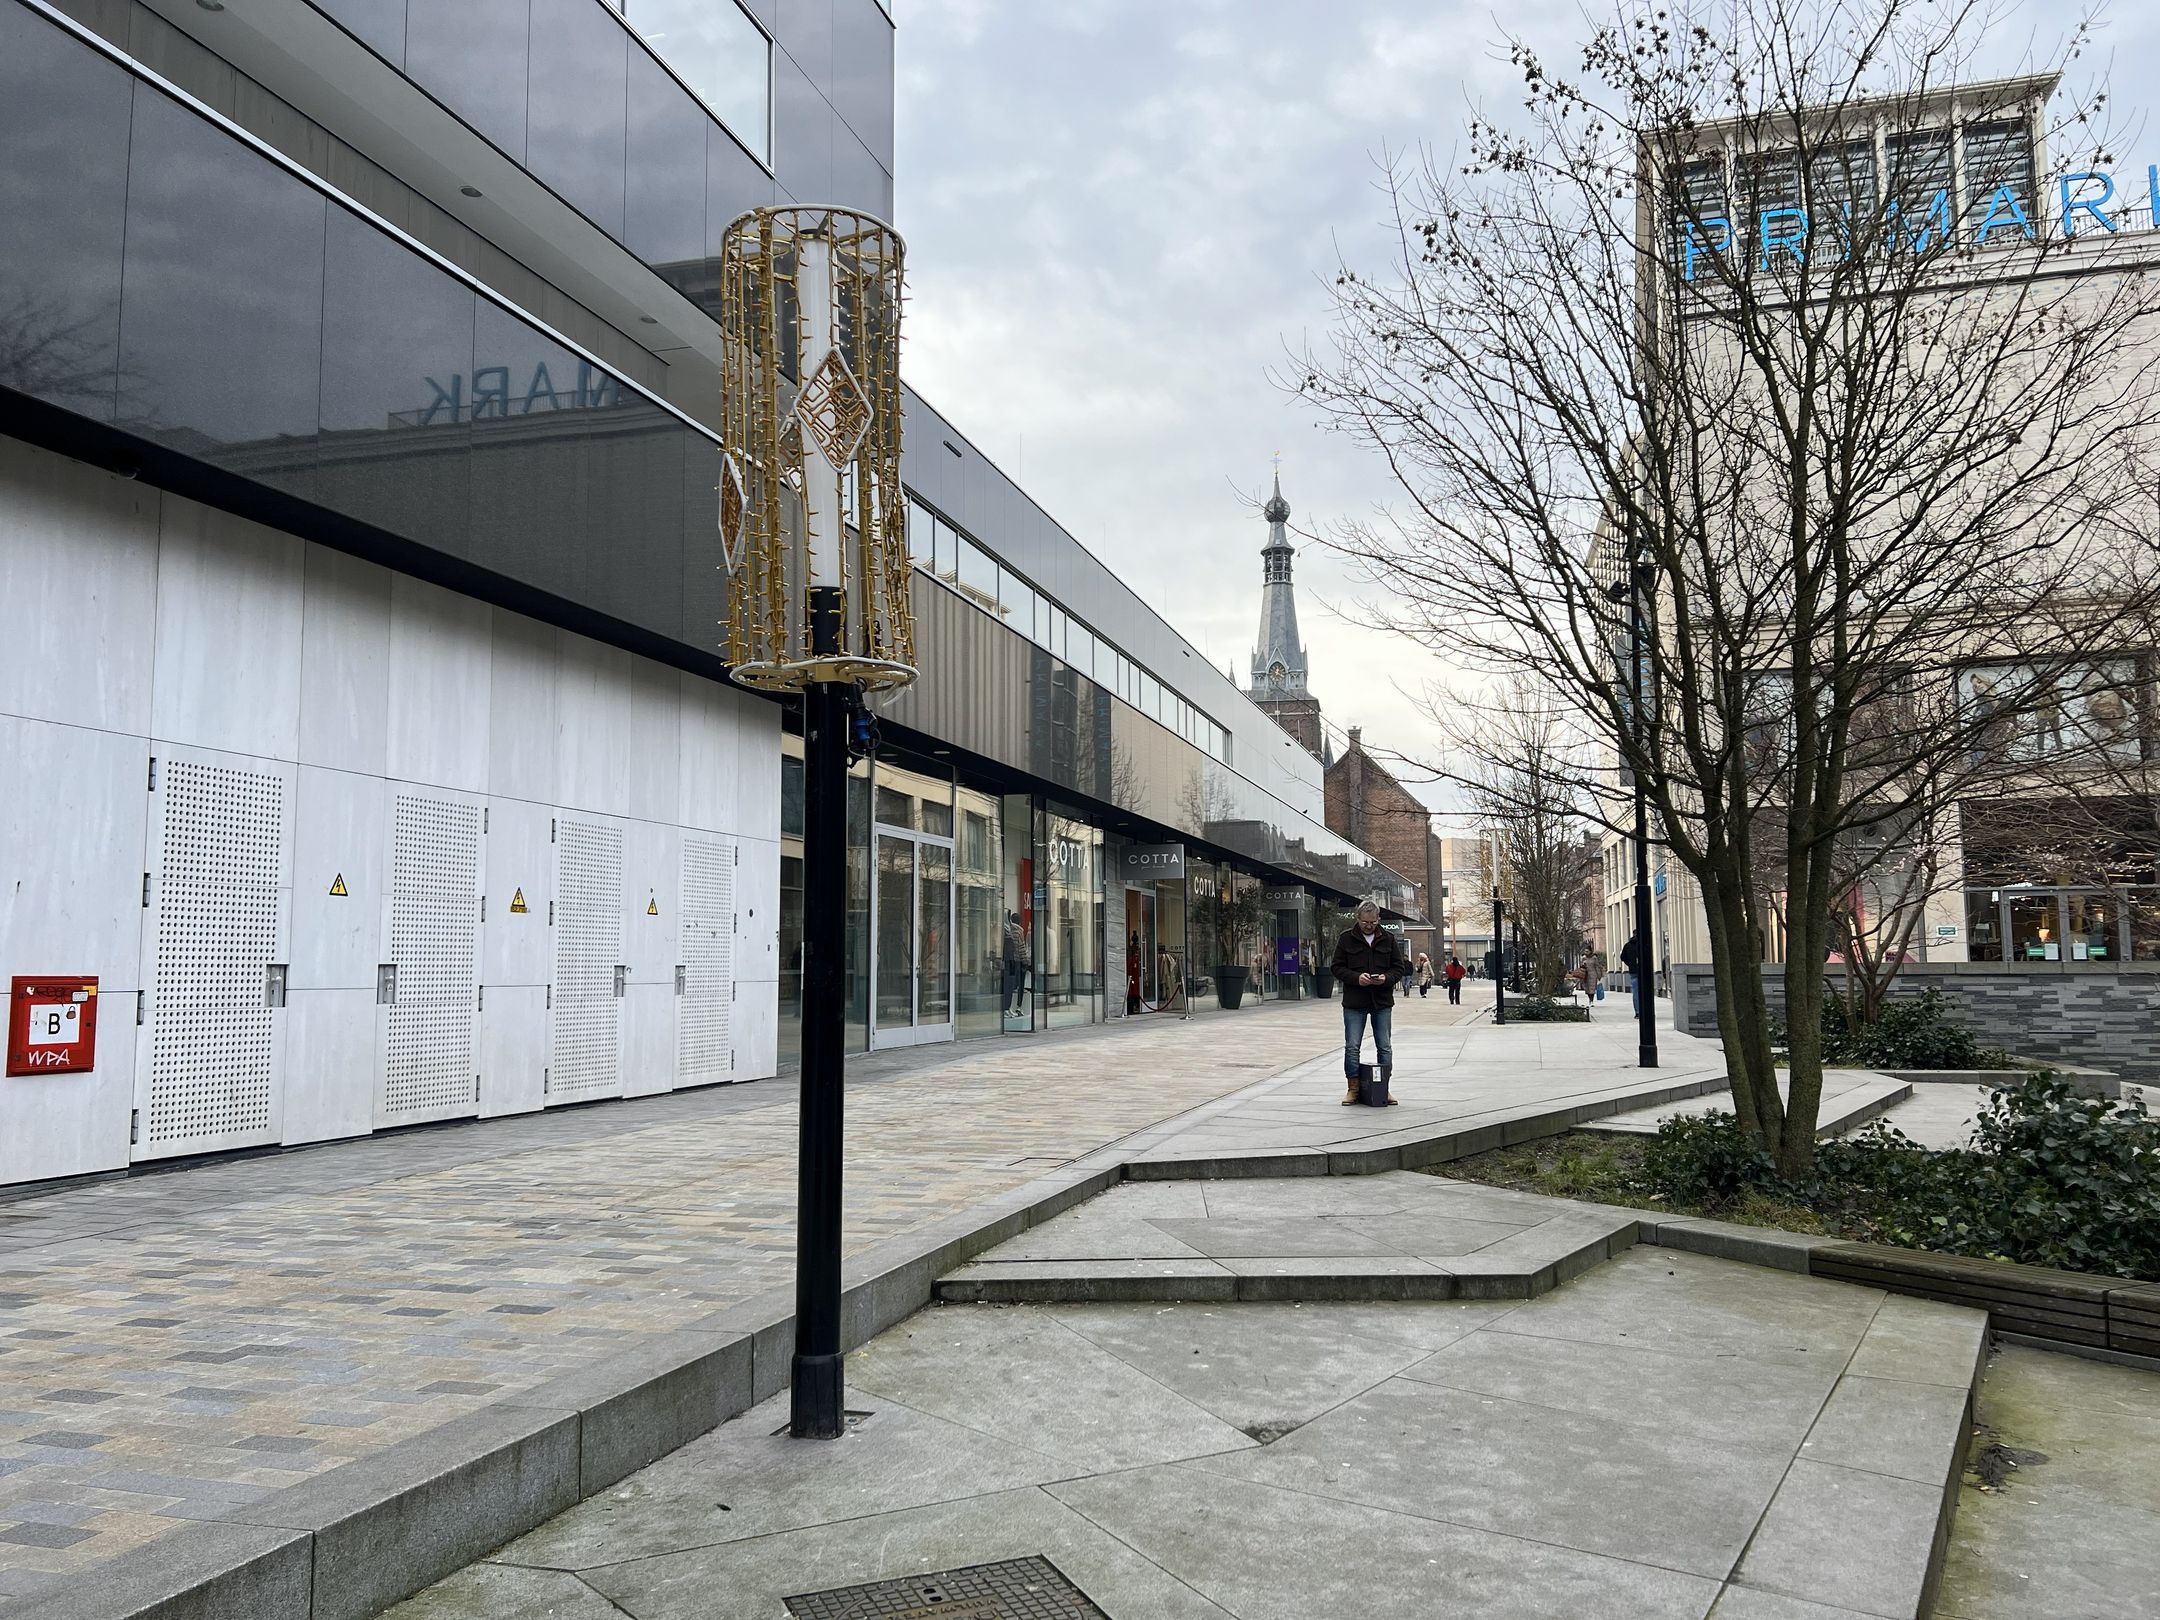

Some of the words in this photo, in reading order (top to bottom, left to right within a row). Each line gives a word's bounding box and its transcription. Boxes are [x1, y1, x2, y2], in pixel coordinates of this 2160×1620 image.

[1685, 164, 2160, 282] PRIMAR
[1048, 838, 1090, 870] COTTA
[1128, 853, 1180, 865] COTTA
[1193, 876, 1216, 898] COTTA
[1265, 891, 1302, 900] COTTA
[48, 1013, 61, 1035] B
[28, 1048, 70, 1067] WPA
